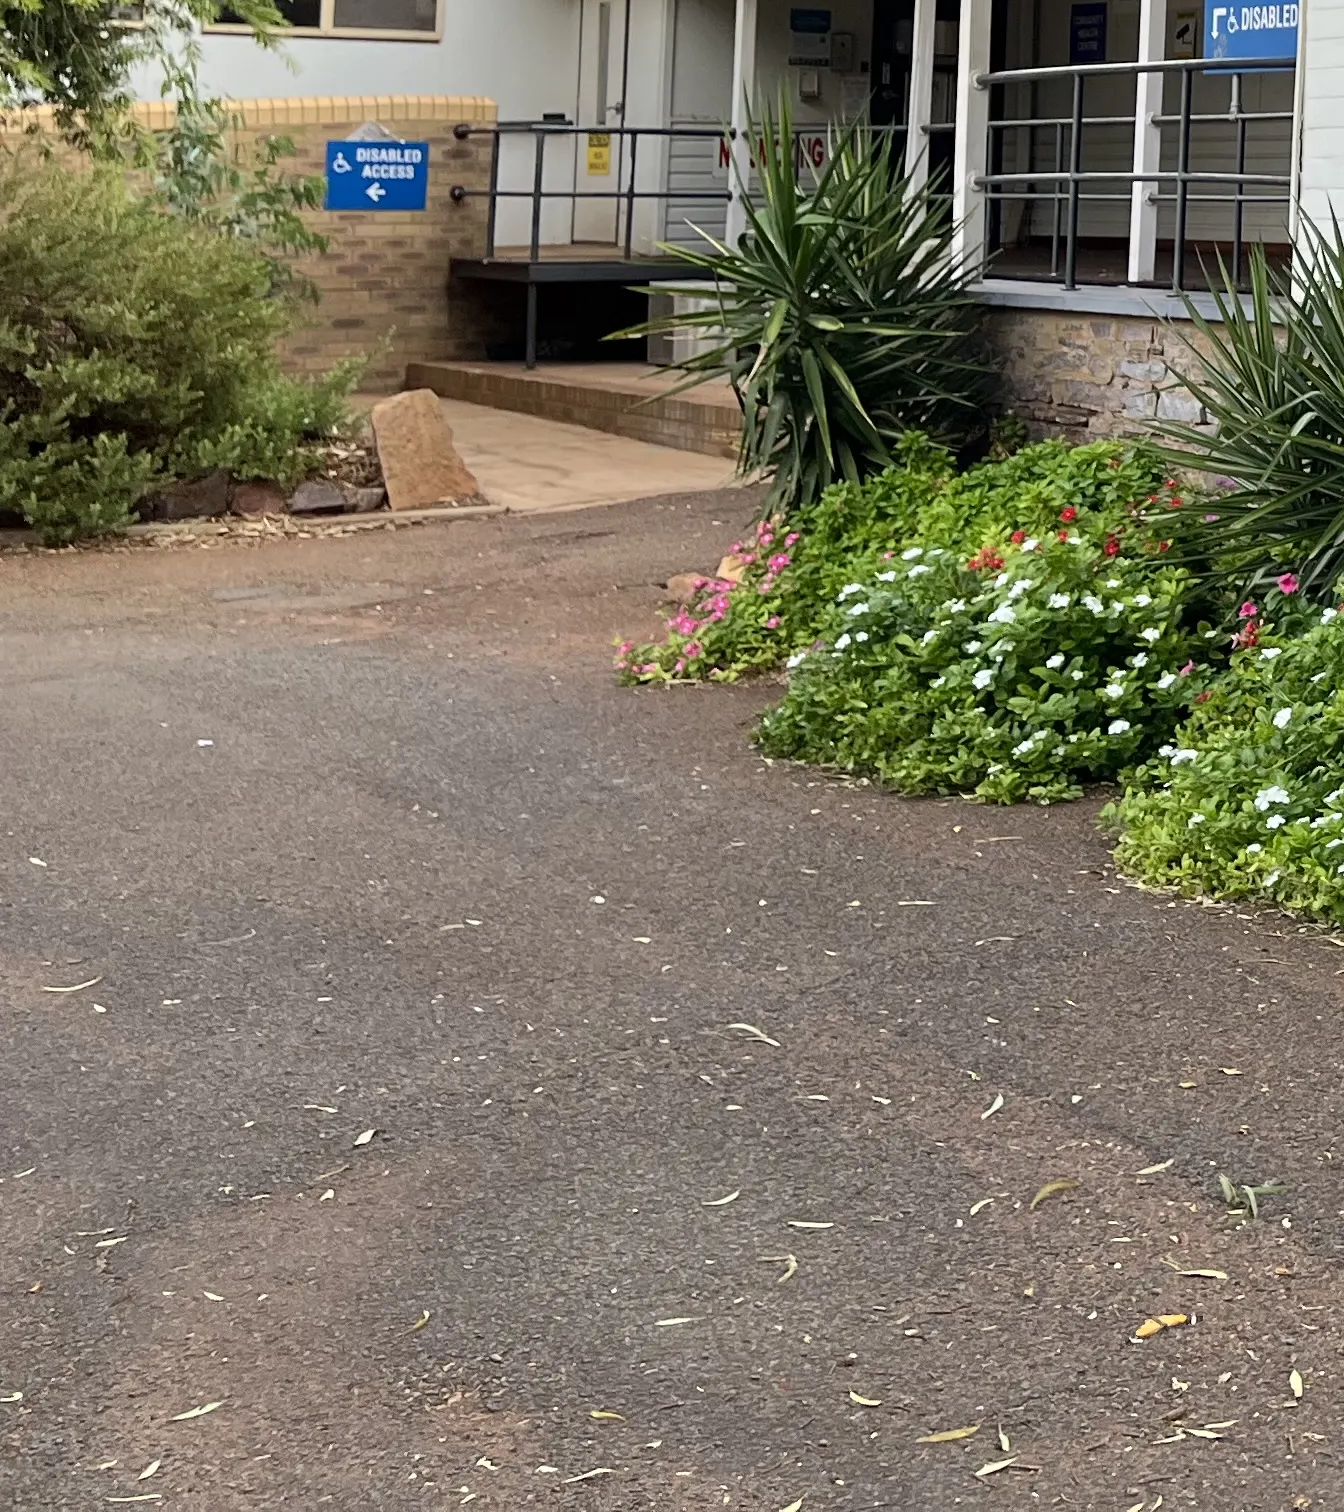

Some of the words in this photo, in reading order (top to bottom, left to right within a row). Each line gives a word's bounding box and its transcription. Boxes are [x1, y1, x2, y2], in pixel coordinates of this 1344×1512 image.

[1241, 4, 1298, 31] DISABLED
[356, 148, 422, 163] DISABLED
[361, 164, 414, 179] ACCESS
